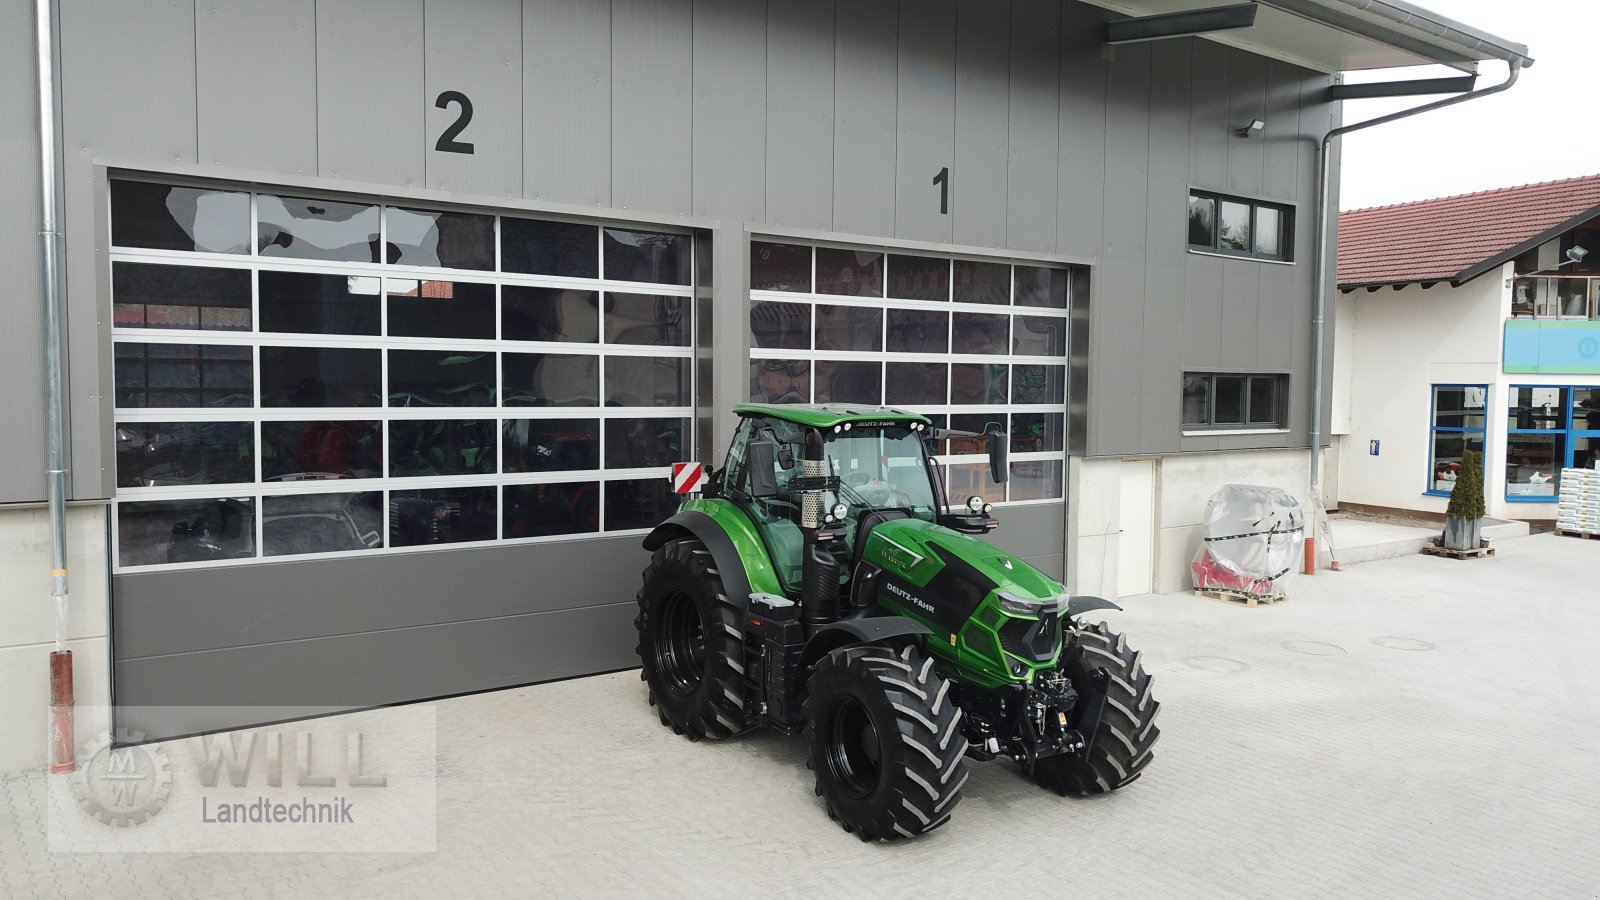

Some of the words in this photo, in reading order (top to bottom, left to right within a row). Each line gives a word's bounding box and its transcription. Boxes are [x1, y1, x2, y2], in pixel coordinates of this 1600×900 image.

[435, 90, 474, 155] 2
[933, 167, 949, 215] 1
[886, 582, 935, 613] DEUTZ-FAHR
